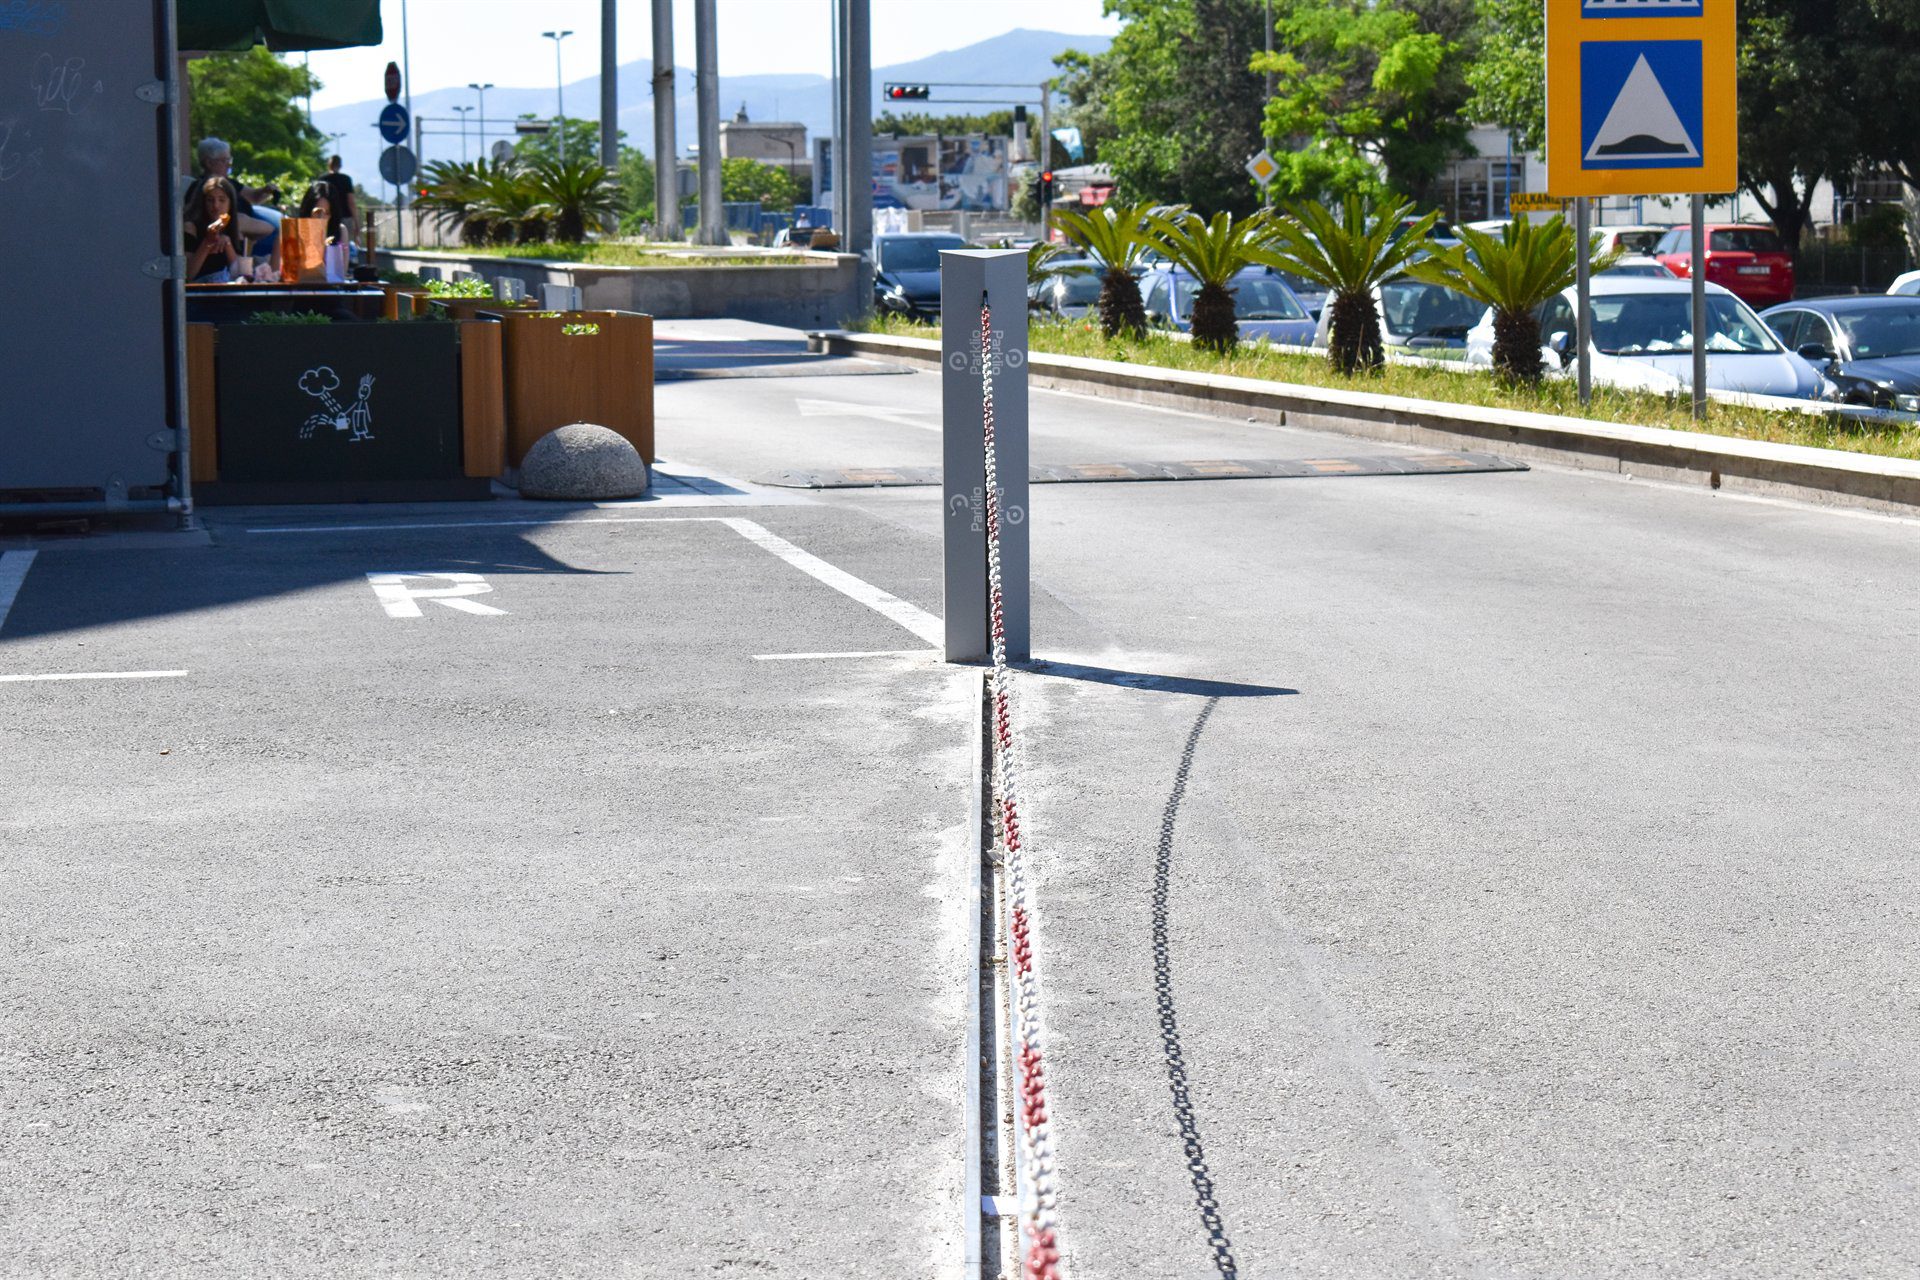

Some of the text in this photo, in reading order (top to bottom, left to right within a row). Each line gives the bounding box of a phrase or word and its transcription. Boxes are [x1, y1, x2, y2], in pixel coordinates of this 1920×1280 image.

[969, 330, 981, 375] Parklio
[992, 330, 1004, 376] Parklio
[971, 487, 982, 532] Parklio
[366, 572, 514, 618] R
